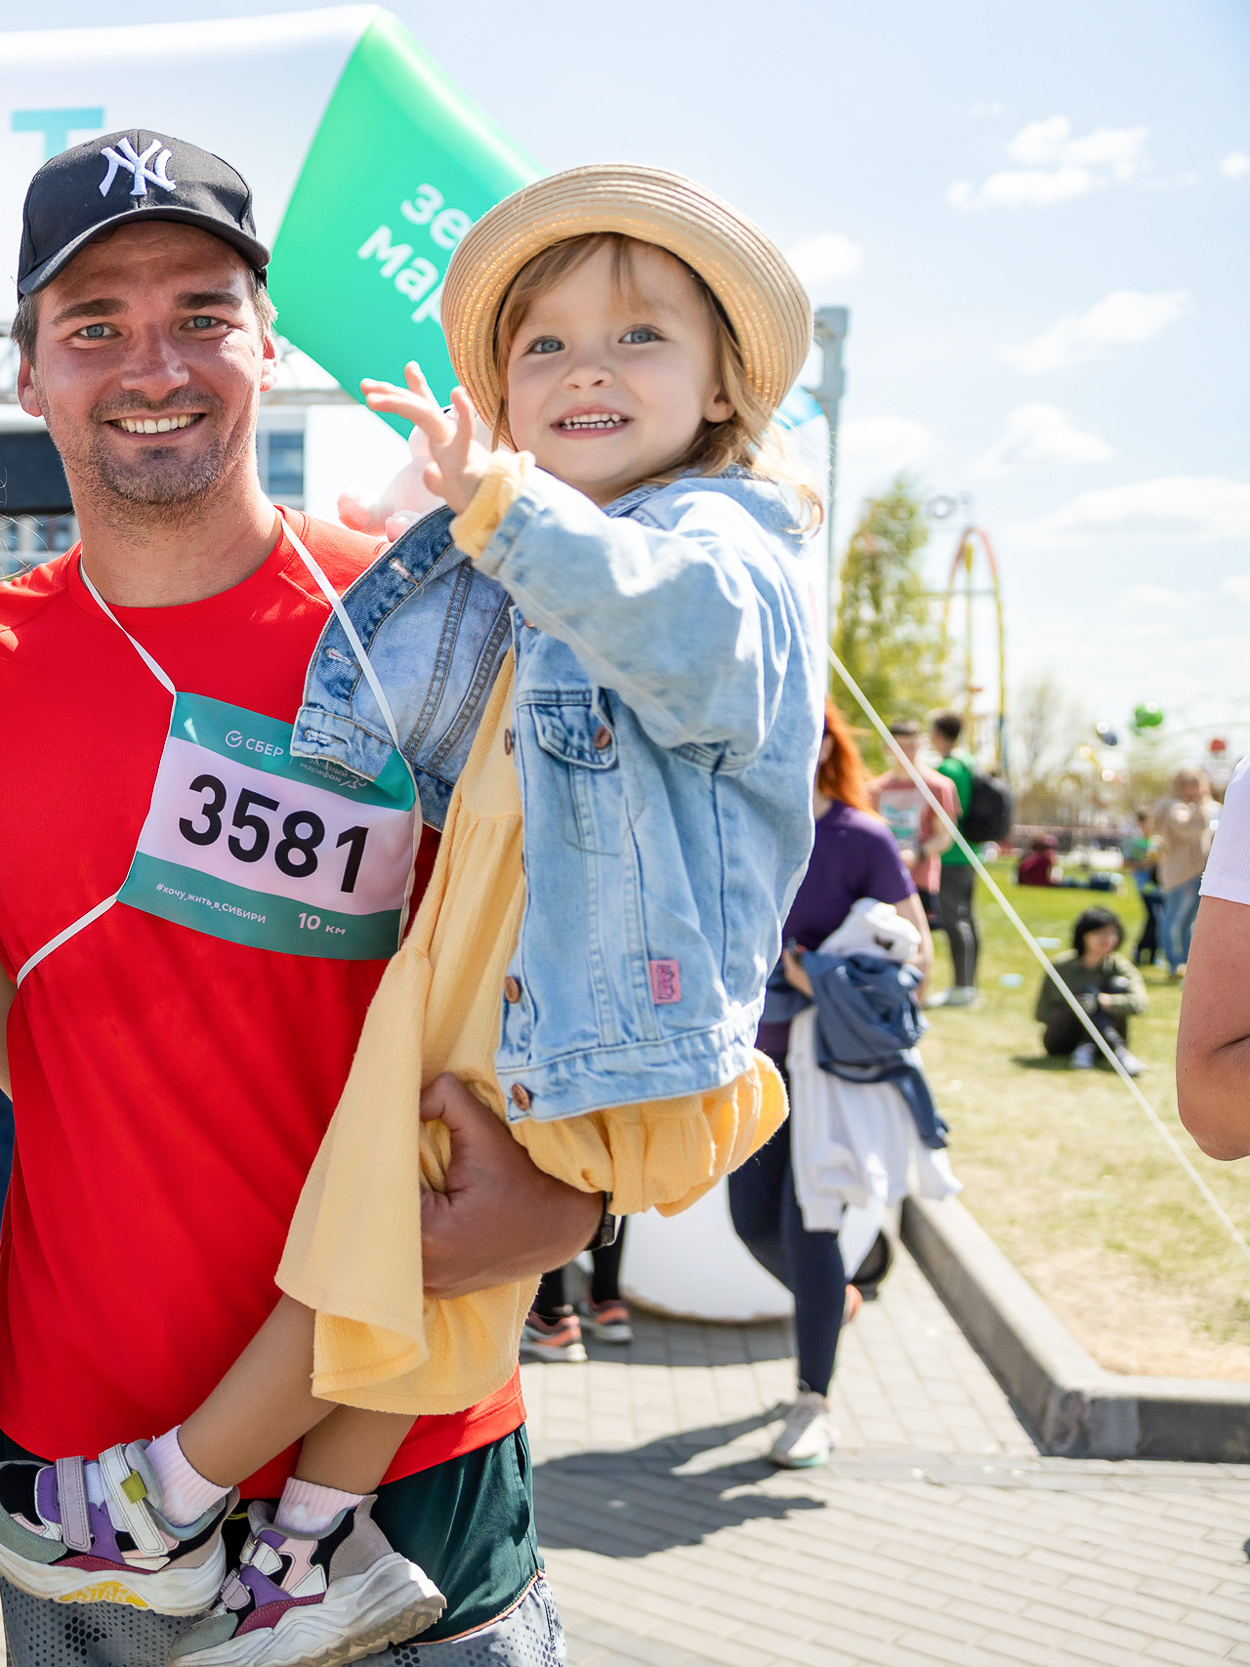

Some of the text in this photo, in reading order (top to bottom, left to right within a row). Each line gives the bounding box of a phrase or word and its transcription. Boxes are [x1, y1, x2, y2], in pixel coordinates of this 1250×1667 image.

[245, 738, 284, 757] СБЕР
[300, 762, 342, 782] марафон
[178, 773, 370, 893] 3581
[298, 912, 346, 935] 10 км
